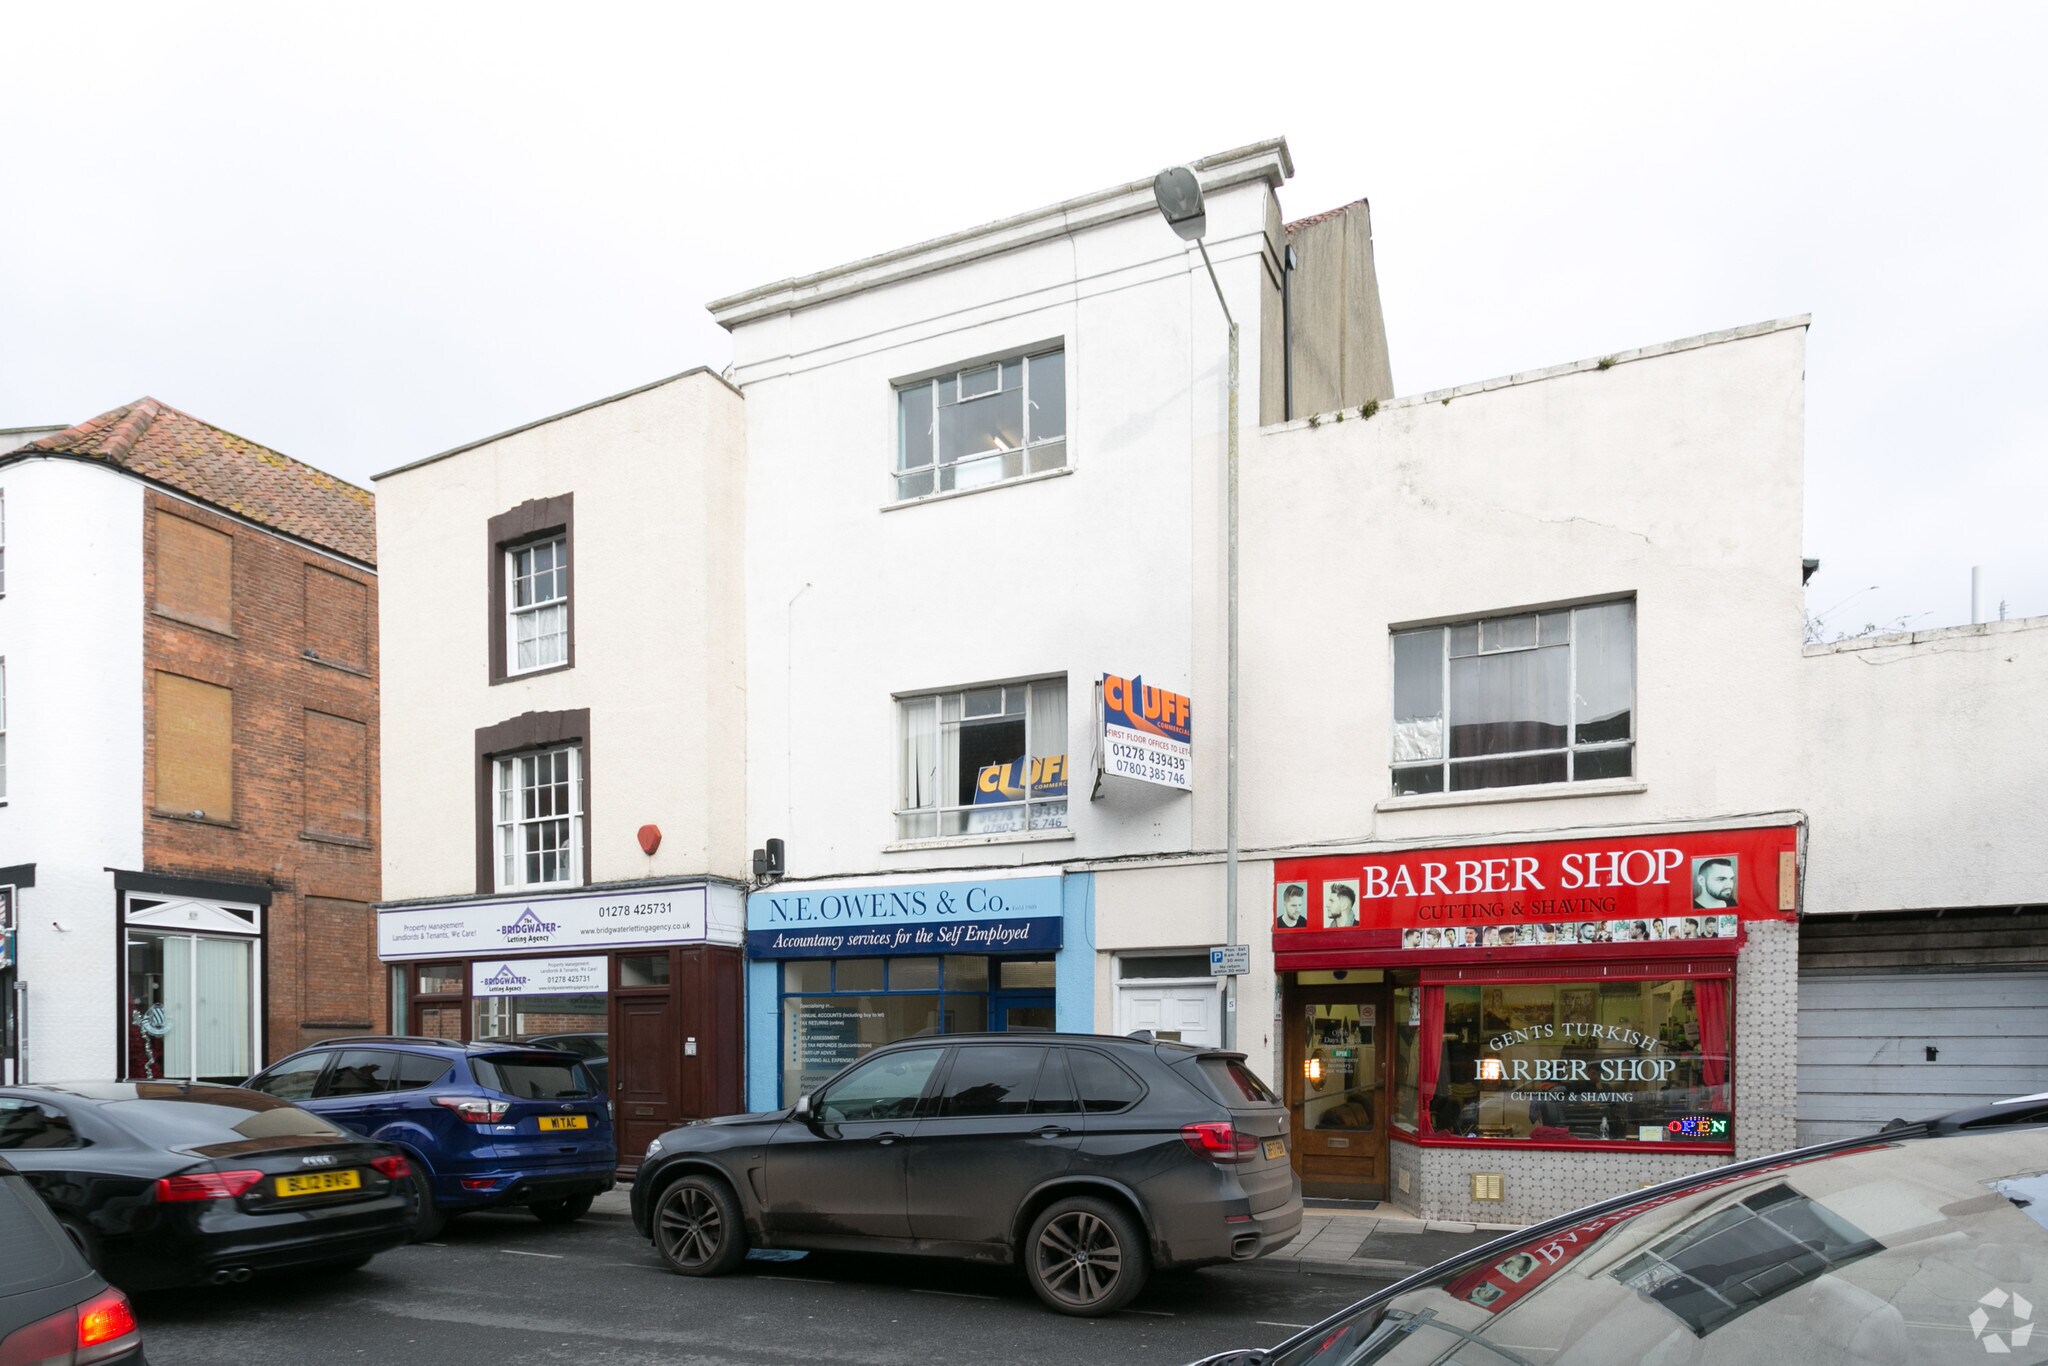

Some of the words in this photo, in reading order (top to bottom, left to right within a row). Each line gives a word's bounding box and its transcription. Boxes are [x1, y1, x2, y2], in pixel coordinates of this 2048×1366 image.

[1104, 674, 1190, 728] CLUFF
[1157, 721, 1190, 736] COMMERCIAL
[1108, 729, 1125, 739] FIRST
[1127, 733, 1147, 743] FLOOR
[1148, 738, 1169, 749] OFFICES
[1170, 744, 1178, 752] TO
[1179, 746, 1188, 755] LET
[1112, 743, 1145, 761] 01278
[1149, 752, 1185, 770] 439439
[1116, 759, 1147, 776] 07802
[1149, 766, 1166, 780] 385
[1168, 771, 1185, 784] 746
[1042, 817, 1062, 829] 746
[1362, 856, 1546, 899] BARBER
[1561, 848, 1684, 890] SHOP
[936, 890, 957, 915] &
[966, 887, 1010, 913] Co.
[599, 904, 630, 918] 01278
[634, 902, 672, 915] 425731
[1418, 902, 1505, 922] CUTTING
[1511, 901, 1525, 915] &
[1531, 896, 1616, 915] SHAVING
[403, 922, 427, 932] Property
[428, 921, 464, 931] Management
[501, 922, 556, 935] BRIDGWATER
[580, 922, 691, 935] www.bridgwaterlettingagency.co.uk
[392, 932, 419, 942] Landlords
[421, 932, 425, 940] &
[451, 929, 461, 938] We
[462, 929, 477, 938] Care!
[507, 934, 527, 944] Letting
[528, 934, 549, 943] Agency
[772, 933, 843, 951] Accountancy
[847, 929, 891, 946] services
[890, 928, 912, 948] for
[915, 927, 933, 943] the
[937, 925, 965, 946] Self
[965, 923, 1031, 946] Employed
[1214, 952, 1222, 962] P
[1489, 1023, 1554, 1052] GENTS
[1561, 1022, 1659, 1052] TURKISH
[1600, 1058, 1677, 1081] SHOP
[1510, 1091, 1565, 1102] CUTTING
[1568, 1091, 1578, 1102] &
[1580, 1091, 1634, 1103] SHAVING
[560, 1117, 577, 1128] TAC
[1667, 1120, 1727, 1133] OPEN
